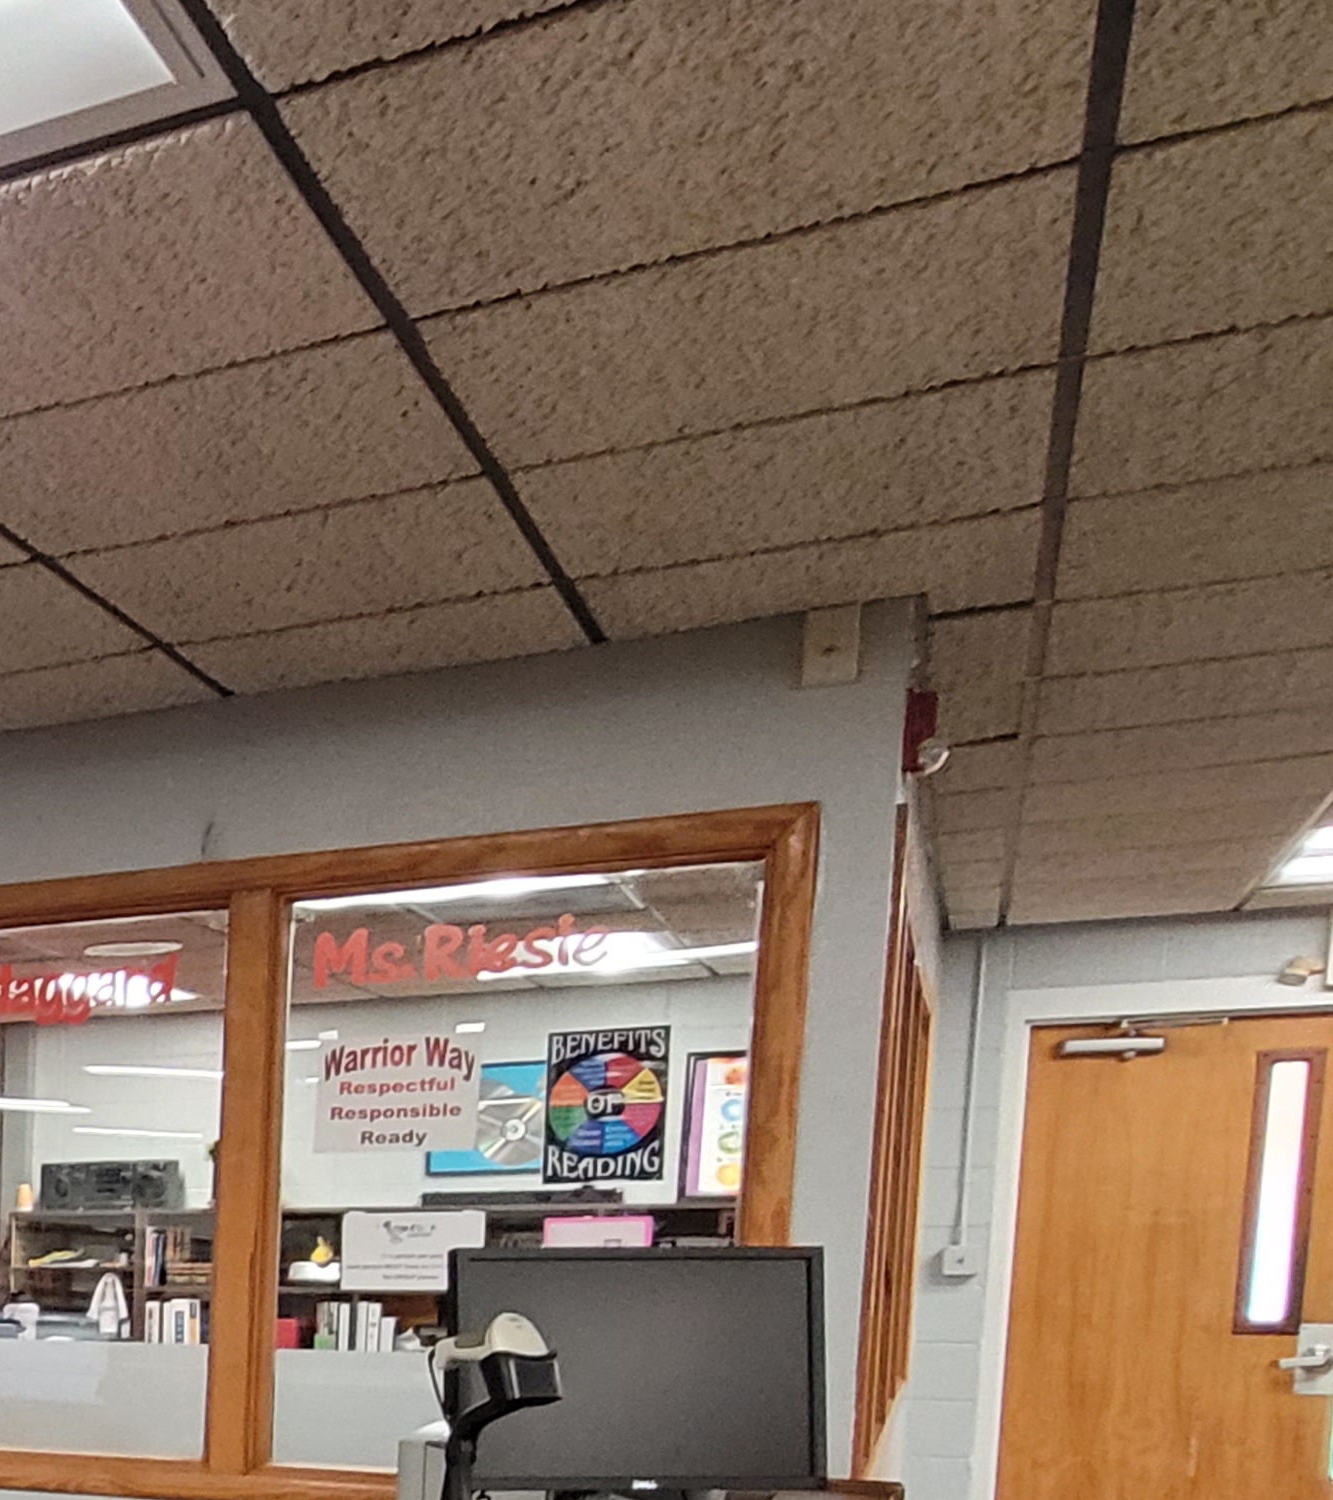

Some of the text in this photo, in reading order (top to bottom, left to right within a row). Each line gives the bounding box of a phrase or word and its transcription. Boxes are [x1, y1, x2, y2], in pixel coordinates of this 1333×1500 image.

[313, 927, 415, 988] Ms.
[324, 1036, 475, 1082] Warrior Way
[551, 1029, 666, 1065] BENEFITS
[339, 1077, 456, 1097] Respectful
[329, 1103, 462, 1123] Responsible
[360, 1129, 428, 1147] Ready
[546, 1141, 661, 1178] READING
